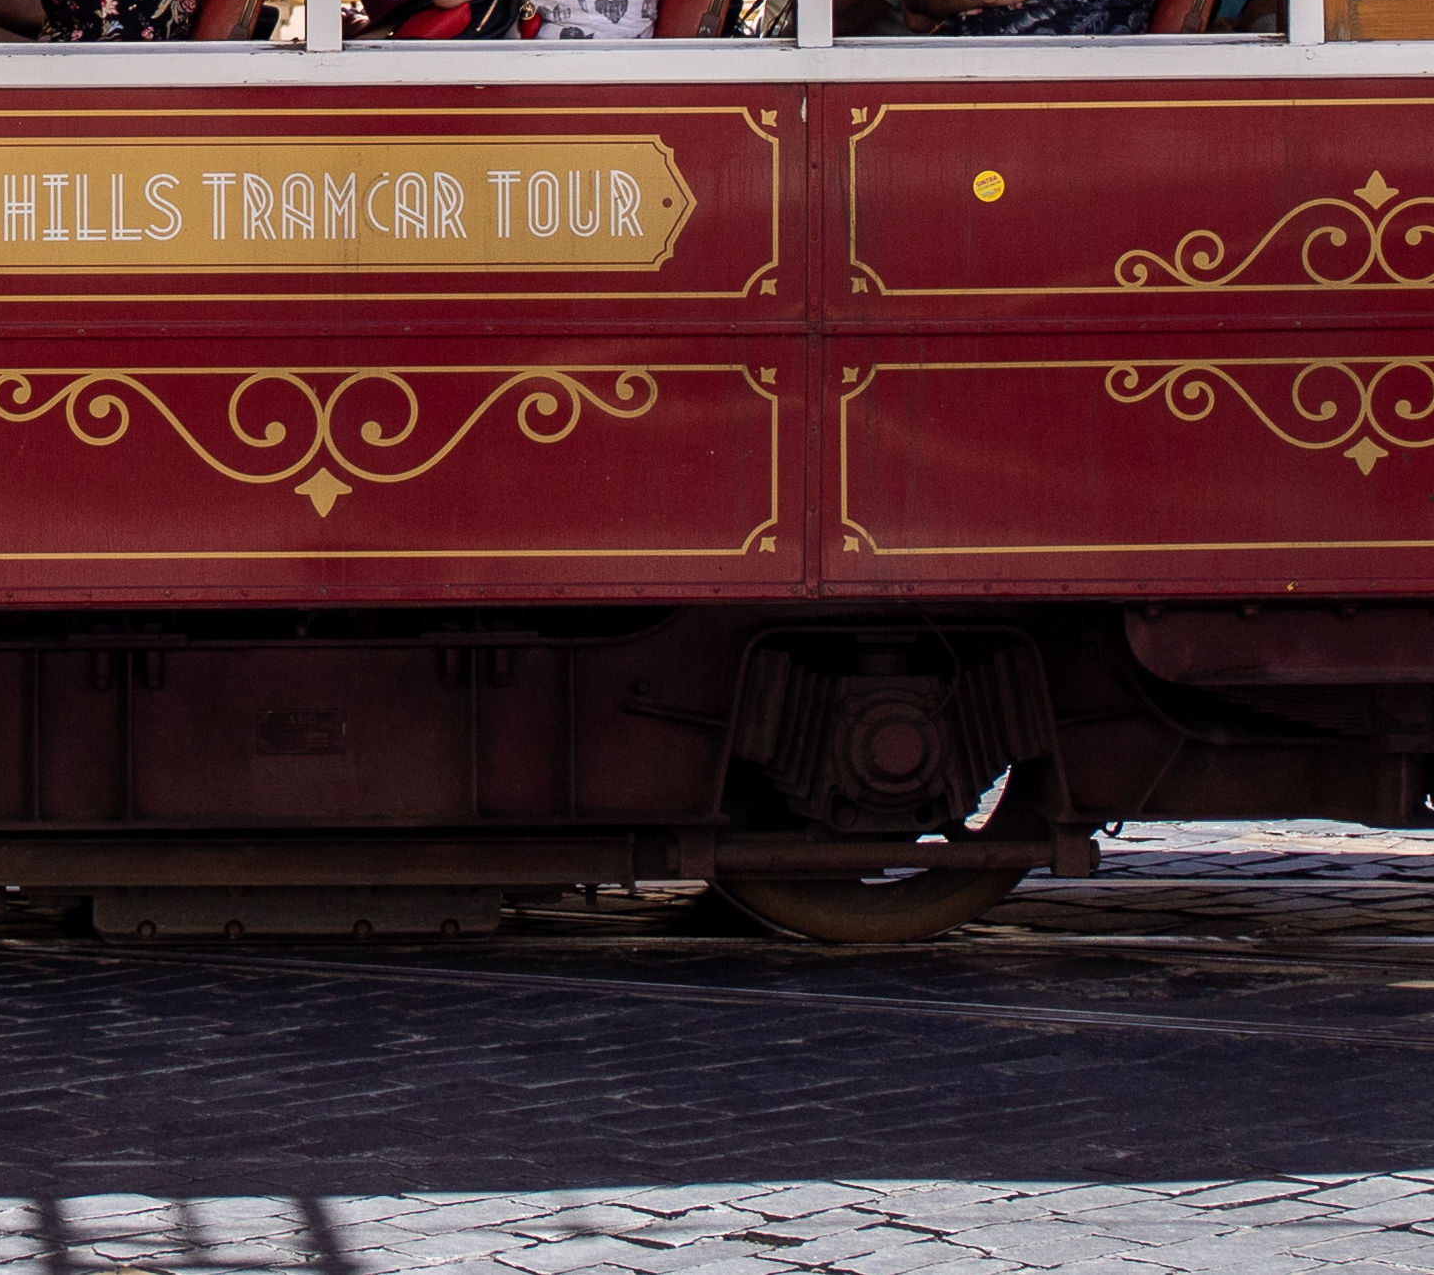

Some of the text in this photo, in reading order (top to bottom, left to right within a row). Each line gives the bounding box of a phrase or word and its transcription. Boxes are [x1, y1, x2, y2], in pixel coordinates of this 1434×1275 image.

[3, 169, 644, 242] HILLS TRAMCAR TOUR
